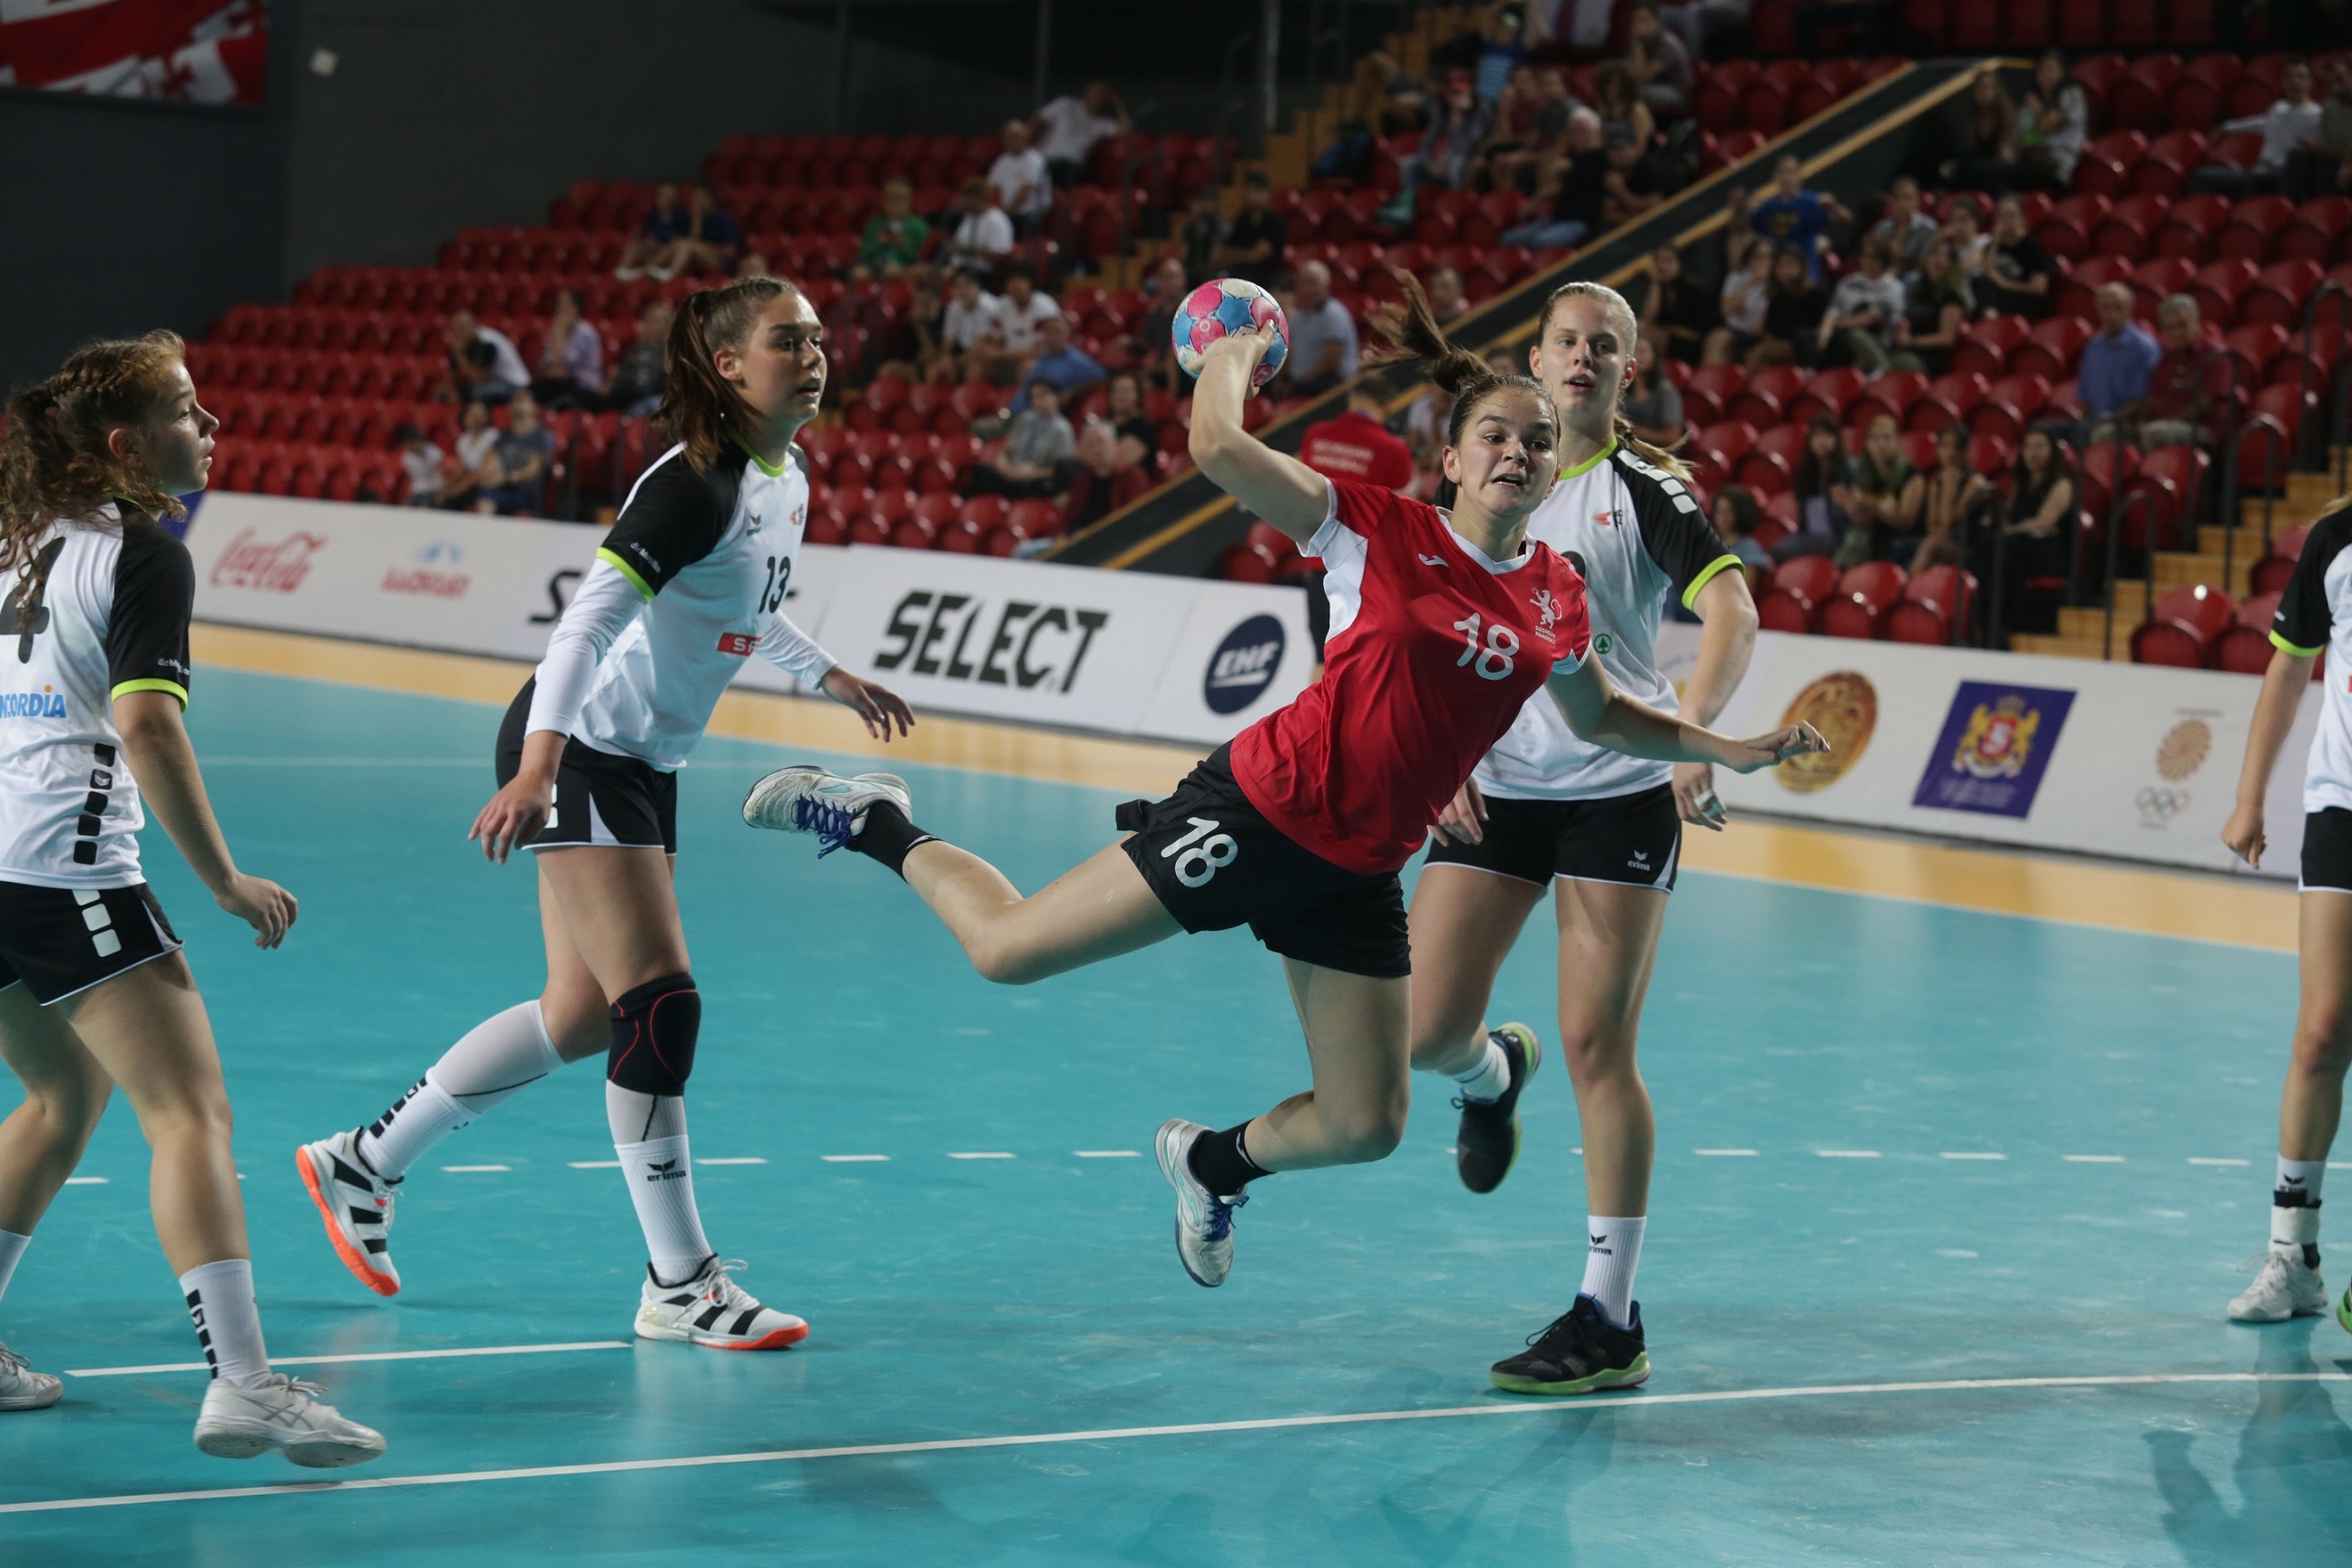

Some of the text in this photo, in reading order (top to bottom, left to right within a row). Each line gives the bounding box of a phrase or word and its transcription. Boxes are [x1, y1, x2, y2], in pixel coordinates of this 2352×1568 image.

[0, 536, 66, 663] 4
[758, 556, 790, 613] 13
[874, 592, 1108, 693] SELECT
[1214, 641, 1279, 677] EHF
[1454, 612, 1519, 681] 18
[1161, 817, 1238, 887] 18
[647, 1171, 686, 1181] erima
